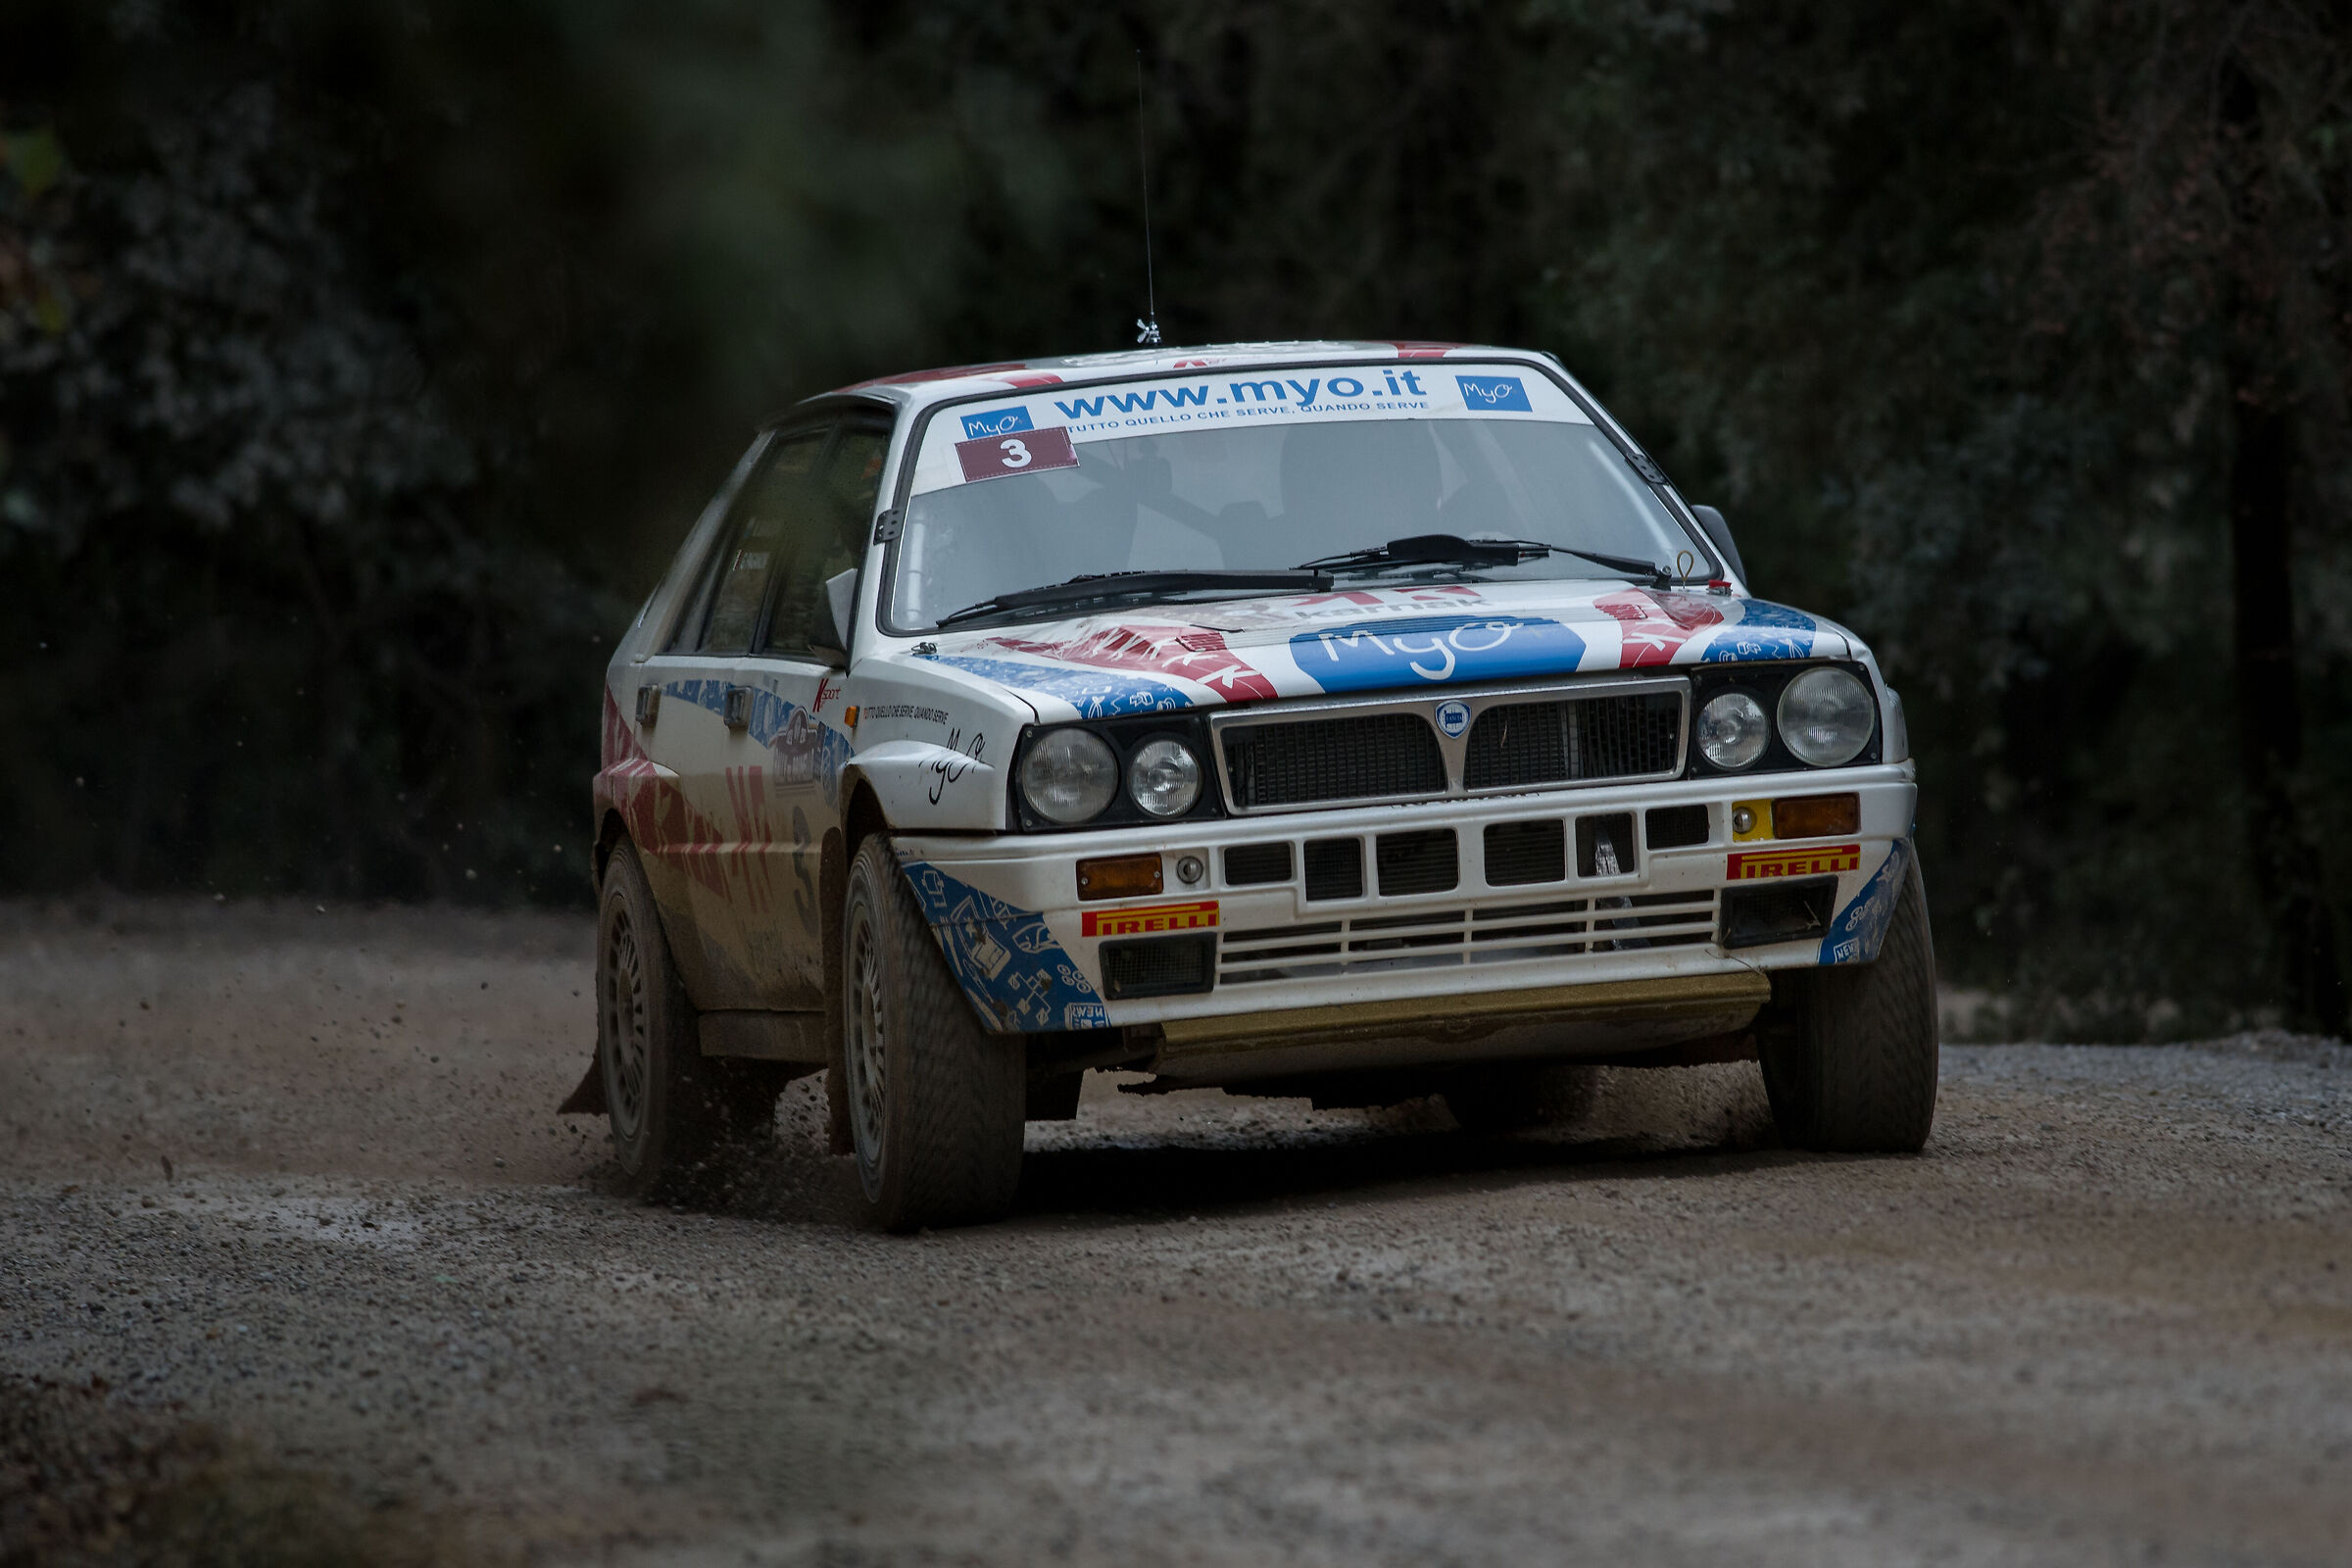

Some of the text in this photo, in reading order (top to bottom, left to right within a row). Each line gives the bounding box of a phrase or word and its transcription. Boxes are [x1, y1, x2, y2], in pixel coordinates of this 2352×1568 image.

[1054, 369, 1427, 419] www.myo.it
[1068, 420, 1119, 434] TUTTO
[1125, 414, 1191, 427] QUELLO
[1198, 410, 1230, 420] CHE
[1300, 403, 1370, 414] QUANDO
[1376, 401, 1429, 410] SERVE
[1000, 438, 1033, 468] 3
[1727, 844, 1861, 880] PIRELLI
[1082, 900, 1219, 937] PIRELLI
